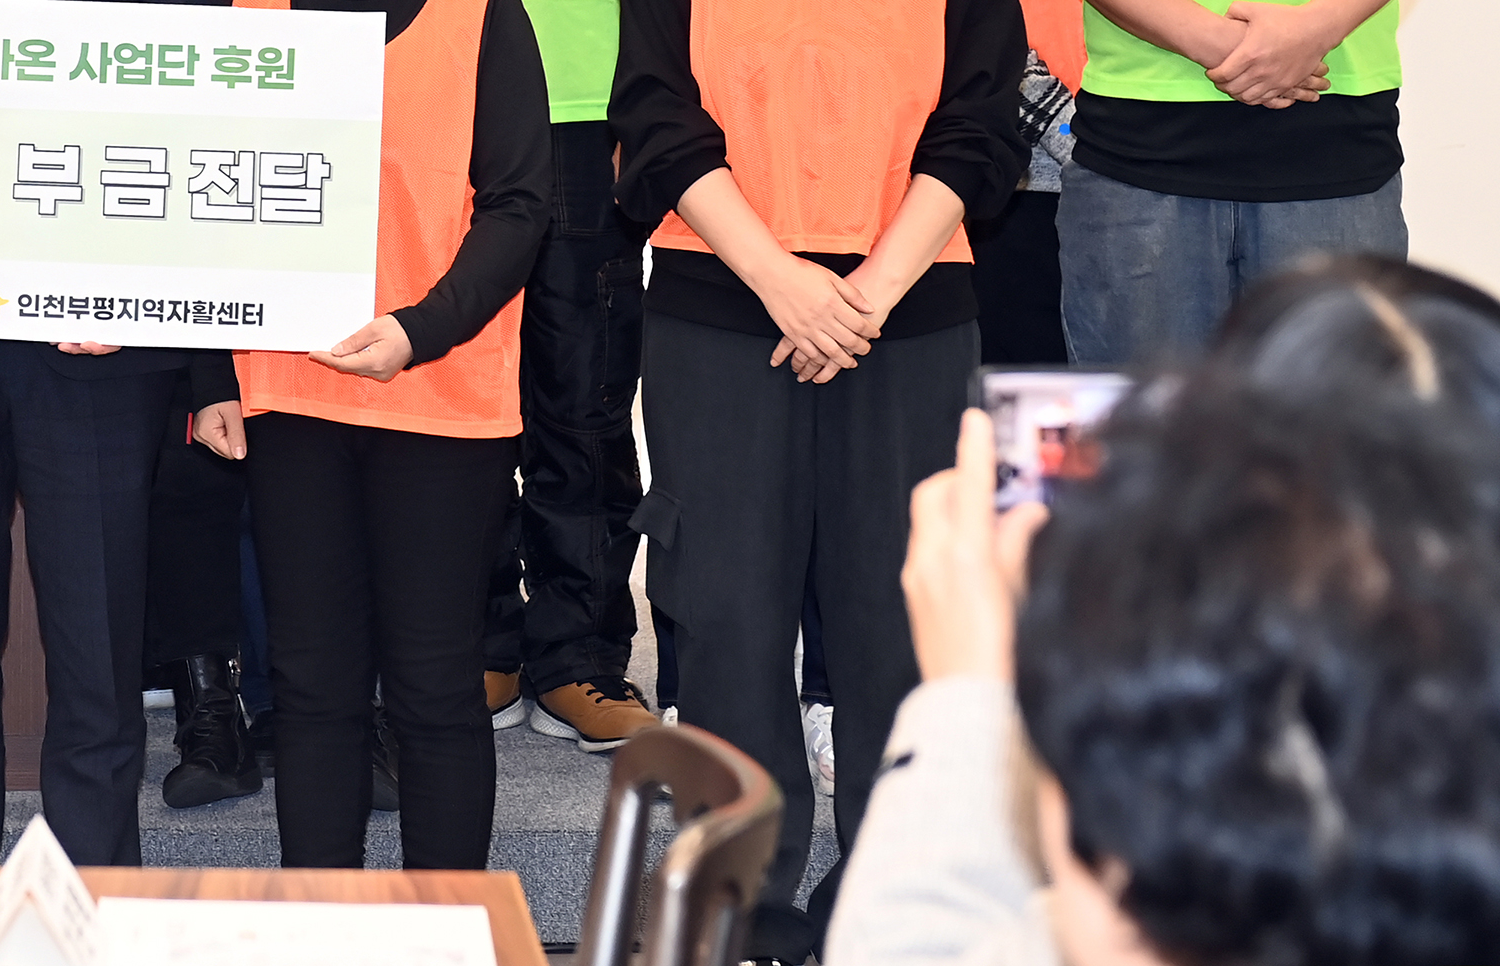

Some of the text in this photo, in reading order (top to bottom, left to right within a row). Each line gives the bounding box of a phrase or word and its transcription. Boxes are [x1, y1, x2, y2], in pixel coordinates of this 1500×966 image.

[69, 42, 200, 87] 사업단
[211, 45, 296, 90] 후원
[17, 294, 265, 327] 인천부평지역자활센터
